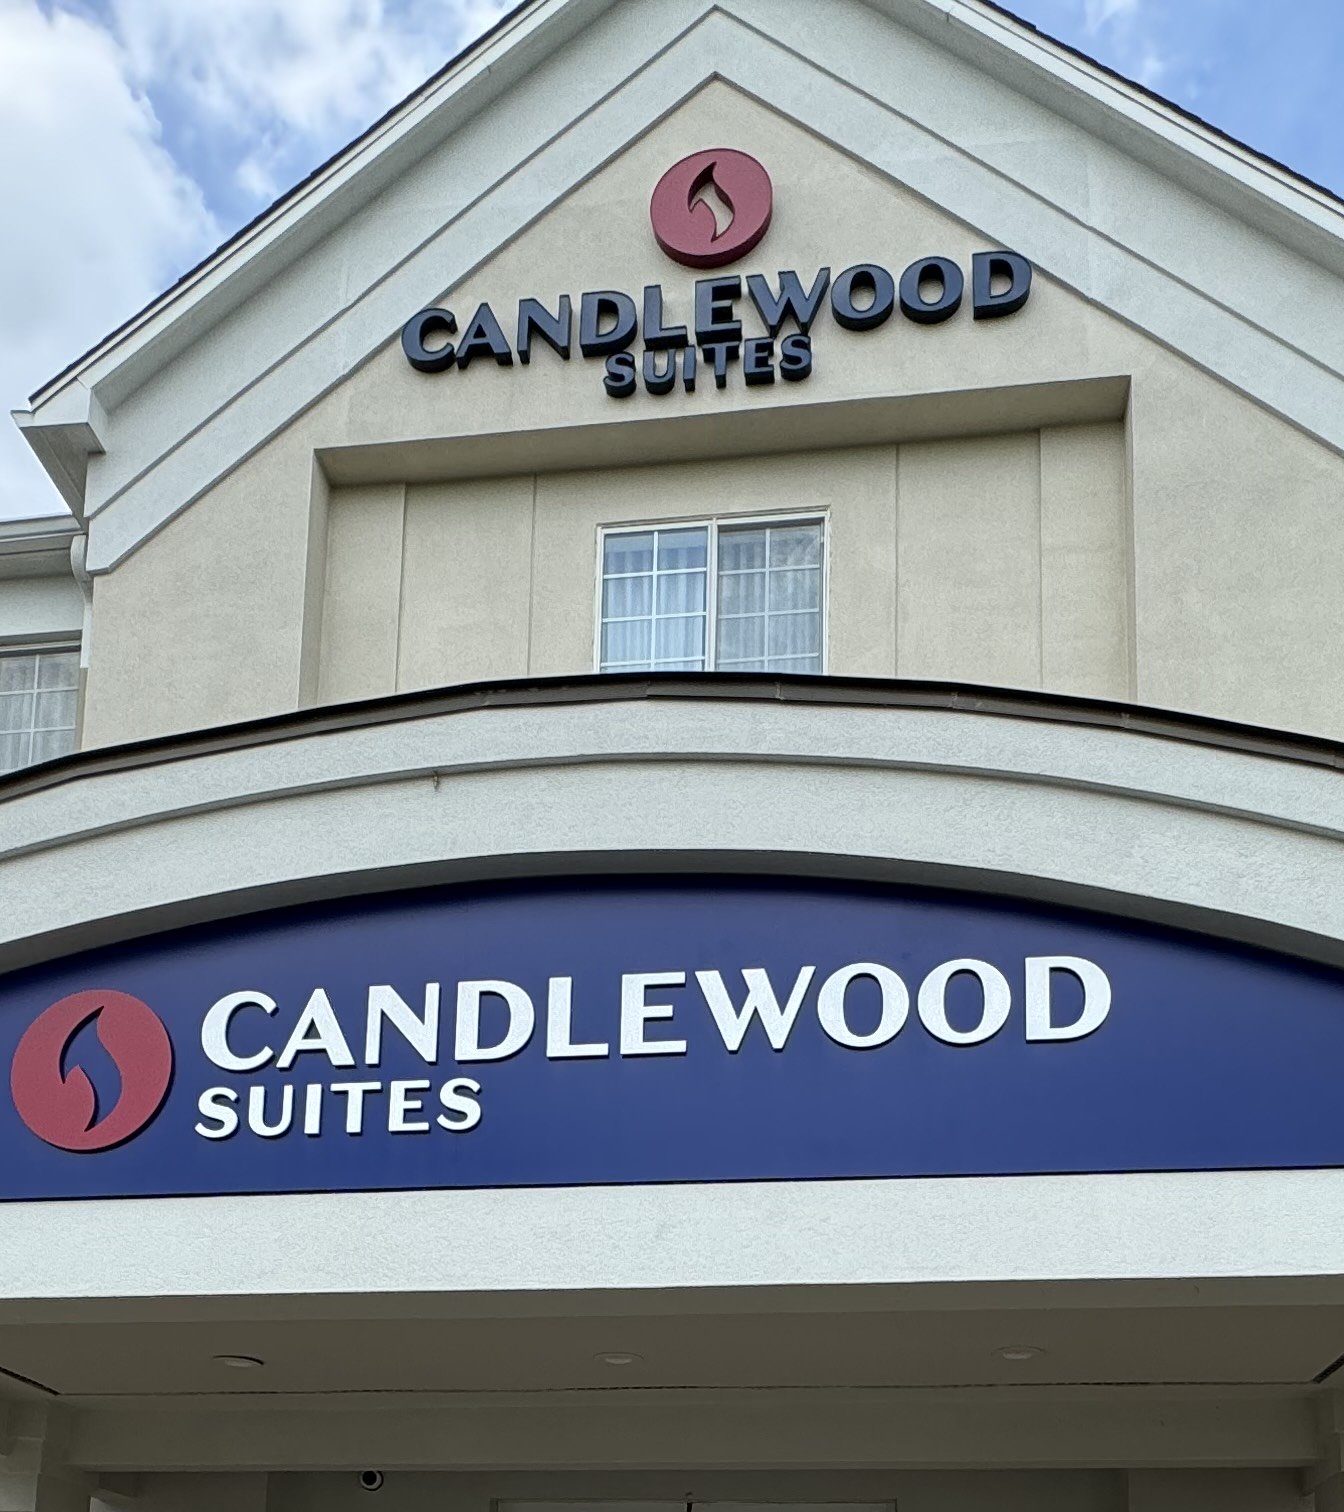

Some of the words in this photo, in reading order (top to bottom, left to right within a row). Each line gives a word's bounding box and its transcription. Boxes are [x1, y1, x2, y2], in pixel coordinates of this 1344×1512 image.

[401, 251, 1033, 373] CANDLEWOOD
[604, 335, 813, 397] SUITES
[199, 955, 1112, 1072] CANDLEWOOD
[194, 1078, 483, 1138] SUITES
